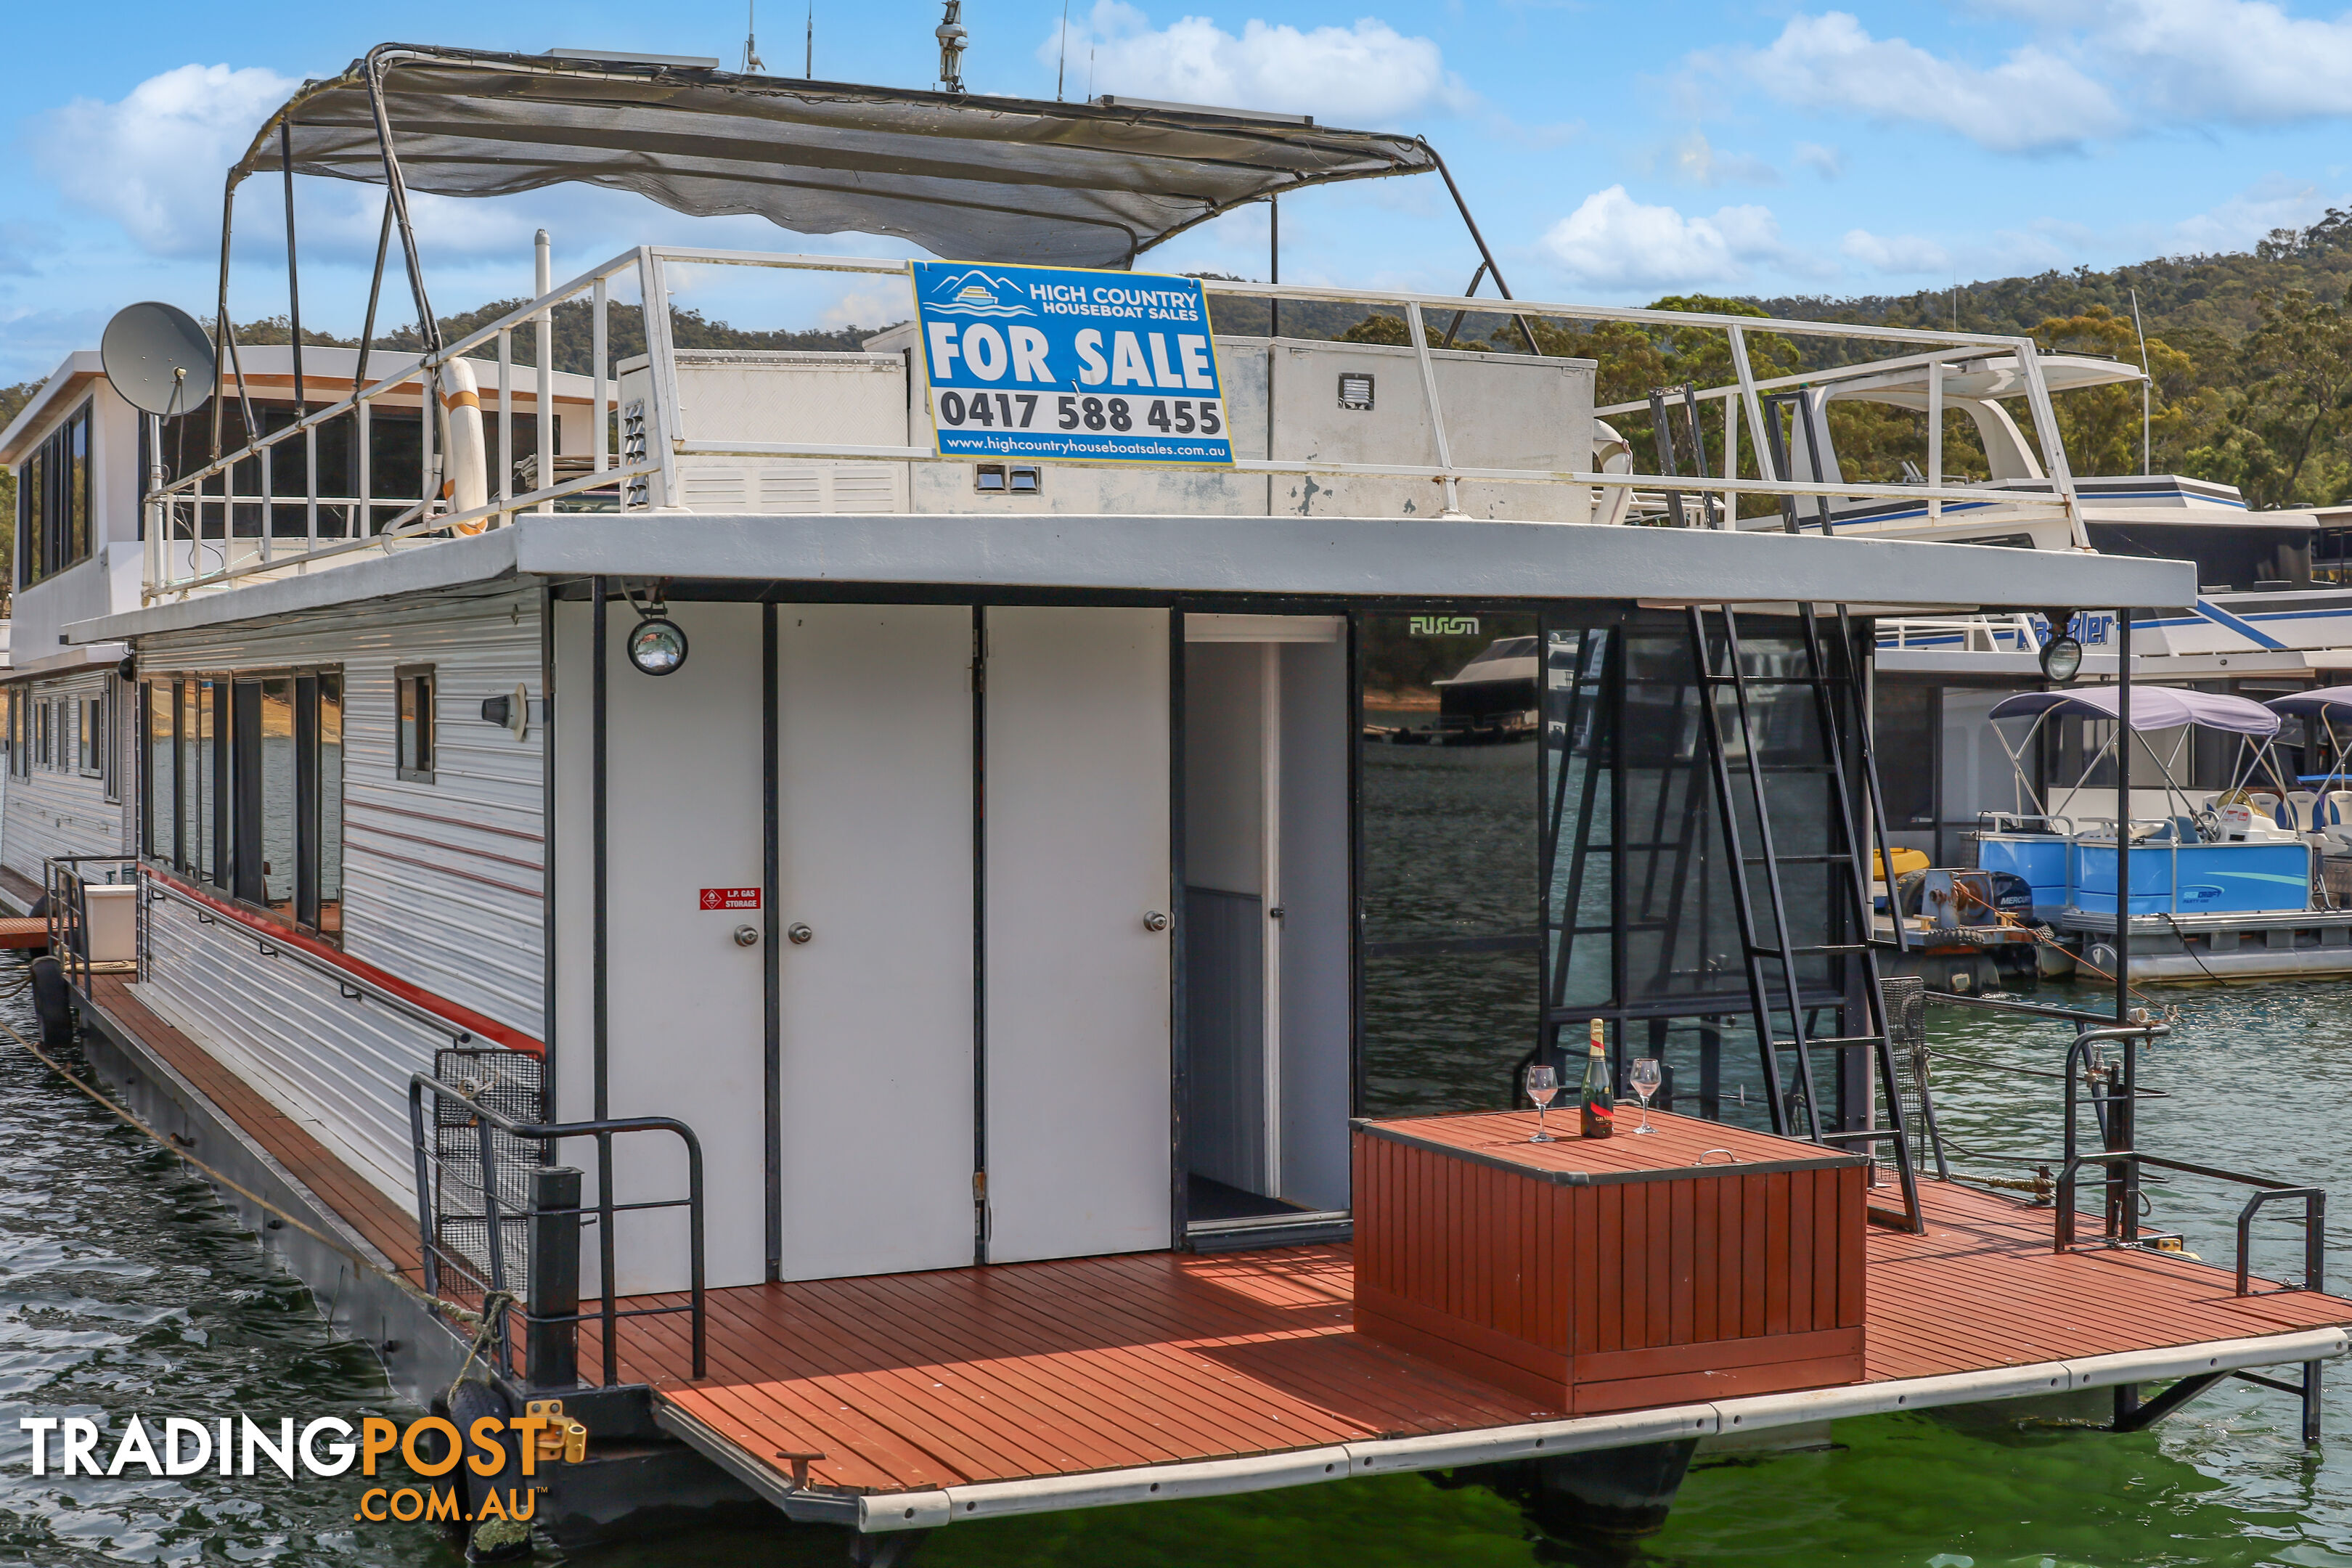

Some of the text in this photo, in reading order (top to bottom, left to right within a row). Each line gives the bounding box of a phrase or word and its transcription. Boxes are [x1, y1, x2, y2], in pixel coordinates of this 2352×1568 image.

[1029, 283, 1197, 309] HIGH COUNTRY
[1042, 302, 1199, 322] HOUSEBOAT SALES
[928, 322, 1214, 390] FOR SALE
[941, 391, 1221, 435] 0417 588 455
[947, 436, 1226, 457] www.highcountryhouseboatsales.com.au
